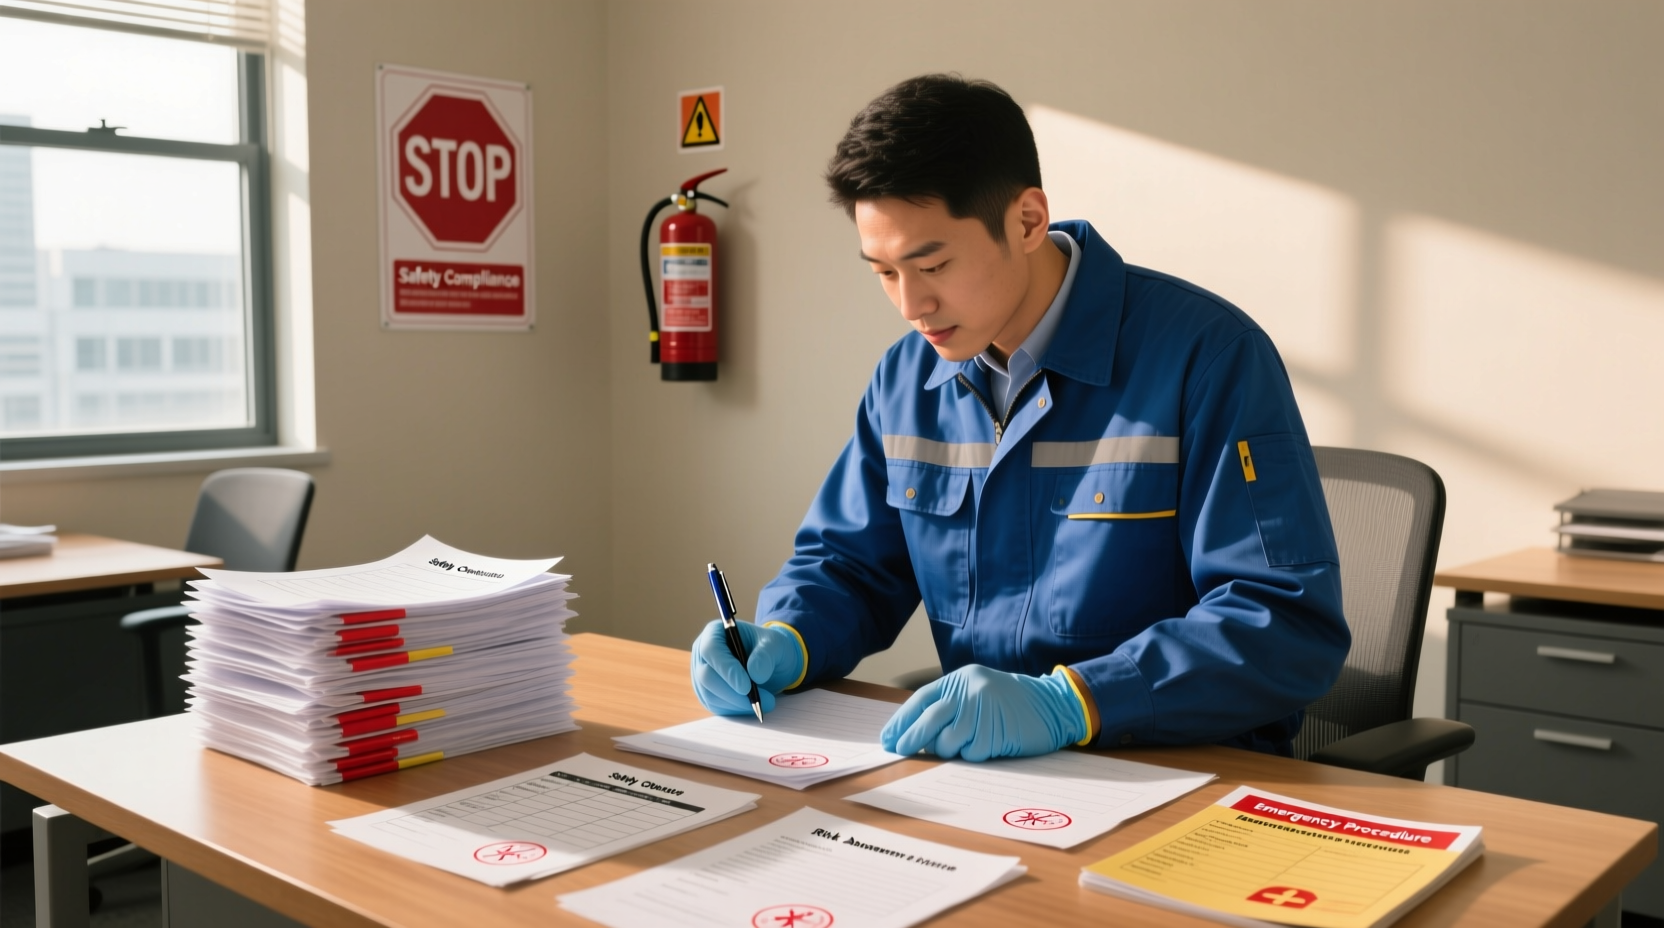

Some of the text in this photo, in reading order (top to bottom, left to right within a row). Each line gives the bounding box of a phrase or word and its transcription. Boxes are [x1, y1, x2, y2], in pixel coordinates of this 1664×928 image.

[405, 134, 512, 202] STOP
[398, 265, 520, 291] Safety Compliance
[1253, 802, 1342, 829] Emergency
